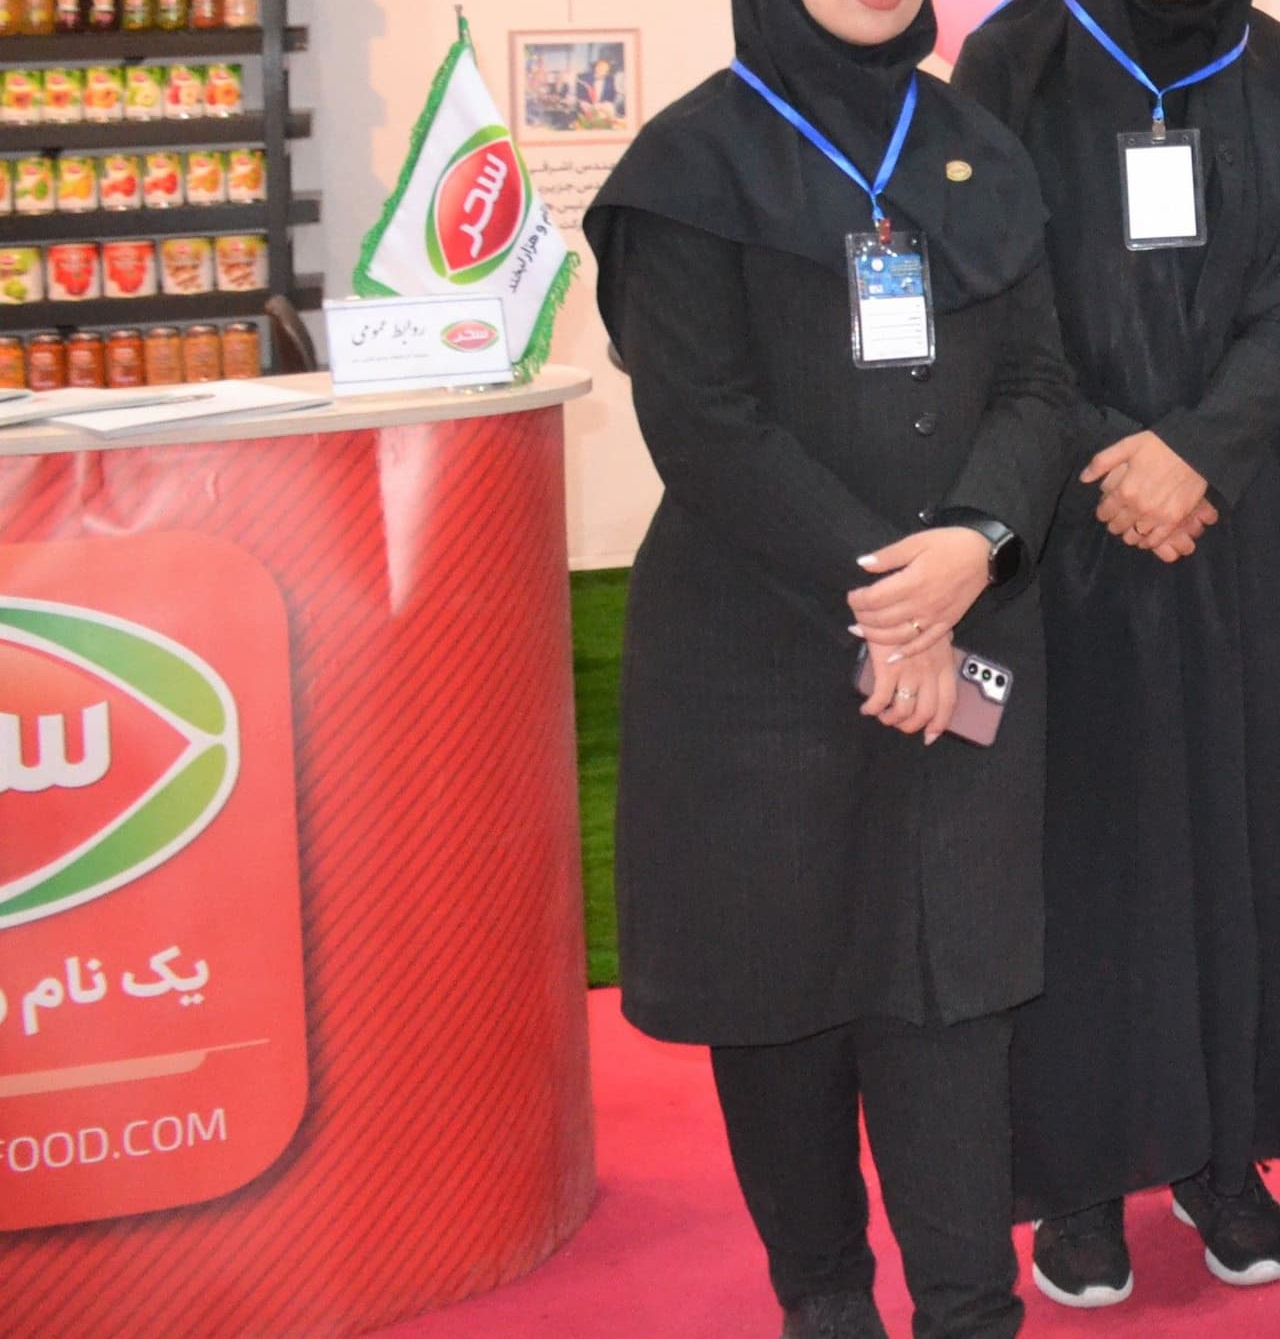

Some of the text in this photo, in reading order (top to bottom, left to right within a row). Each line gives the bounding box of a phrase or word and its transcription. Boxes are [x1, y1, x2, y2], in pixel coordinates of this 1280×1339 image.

[459, 152, 509, 260] سحر
[21, 955, 108, 1037] نام
[121, 944, 210, 1007] یک
